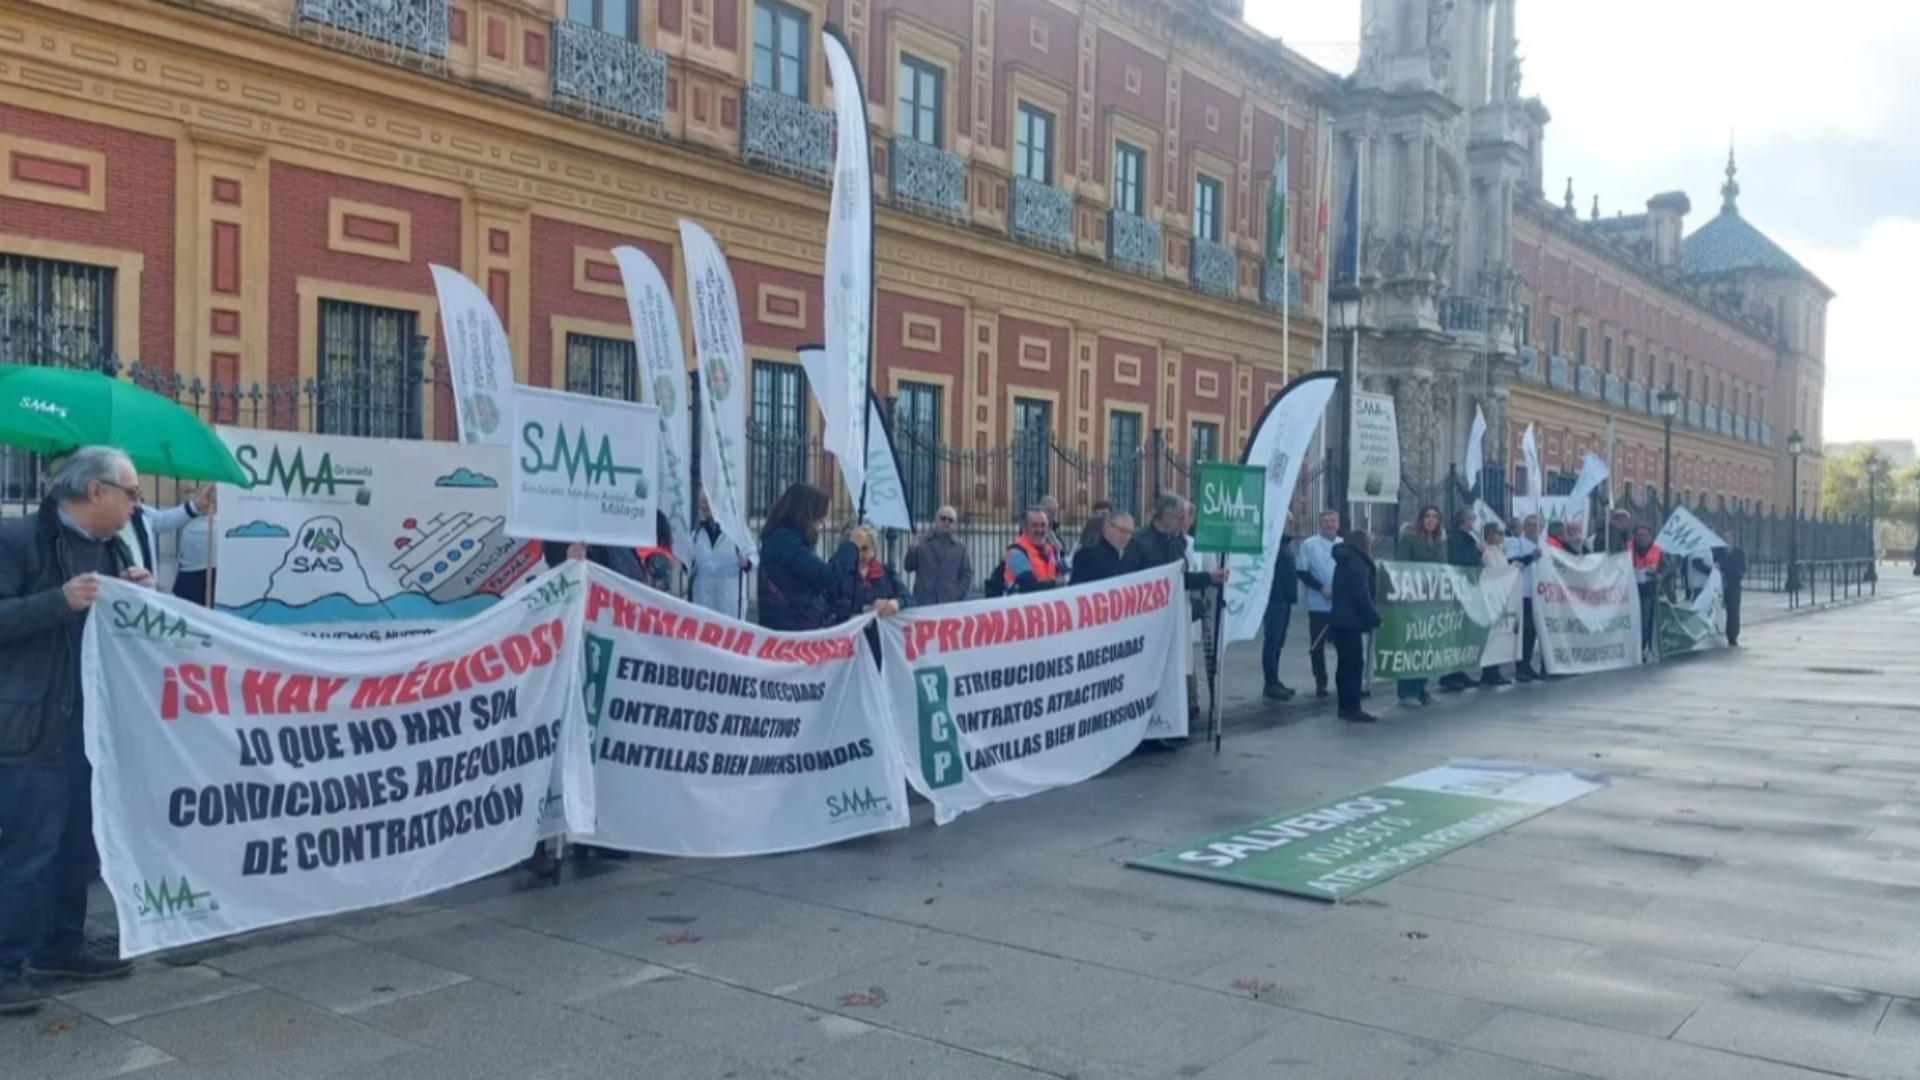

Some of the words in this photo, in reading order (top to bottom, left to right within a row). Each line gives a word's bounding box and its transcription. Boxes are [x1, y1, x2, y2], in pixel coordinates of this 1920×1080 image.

[1356, 398, 1389, 417] SMA
[235, 442, 365, 498] SMA
[334, 463, 373, 477] Granada
[521, 421, 642, 487] SMA
[521, 481, 566, 496] Sindicato
[567, 487, 600, 500] Médico
[600, 502, 646, 519] Málaga
[1203, 480, 1257, 519] SMA
[292, 555, 344, 574] SAS
[113, 599, 210, 640] SMA
[903, 599, 1073, 662] ¡PRIMARIA
[1076, 577, 1171, 630] AGONIZA!
[1405, 606, 1465, 643] nuestra
[161, 663, 229, 721] ¡SI
[242, 667, 349, 716] HAY
[350, 618, 564, 710] MÉDICOS!
[615, 655, 758, 700] ETRIBUCIONES
[954, 655, 1075, 698] ETRIBUCIONES
[1076, 634, 1146, 674] ADECUADAS
[236, 727, 275, 767] LO
[278, 723, 345, 768] QUE
[347, 718, 398, 756] NO
[401, 700, 462, 746] HAY
[470, 685, 518, 731] SON
[608, 696, 720, 736] ONTRATOS
[720, 713, 801, 739] ATRACTIVOS
[956, 697, 1044, 735] ONTRATOS
[1046, 674, 1125, 715] ATRACTIVOS
[598, 736, 710, 775] LANTILLAS
[711, 752, 749, 777] BIEN
[965, 734, 1042, 773] LANTILLAS
[1044, 721, 1076, 750] BIEN
[169, 765, 409, 828] CONDICIONES
[414, 719, 562, 797] ADECUADAS
[826, 786, 888, 818] SMA
[242, 835, 289, 877] DE
[294, 782, 524, 871] CONTRATACIÓN
[1177, 796, 1405, 867] SALVEMOS
[1299, 815, 1420, 865] nuestra
[1306, 839, 1446, 893] ATENCIÓN
[132, 874, 211, 918] SMA
